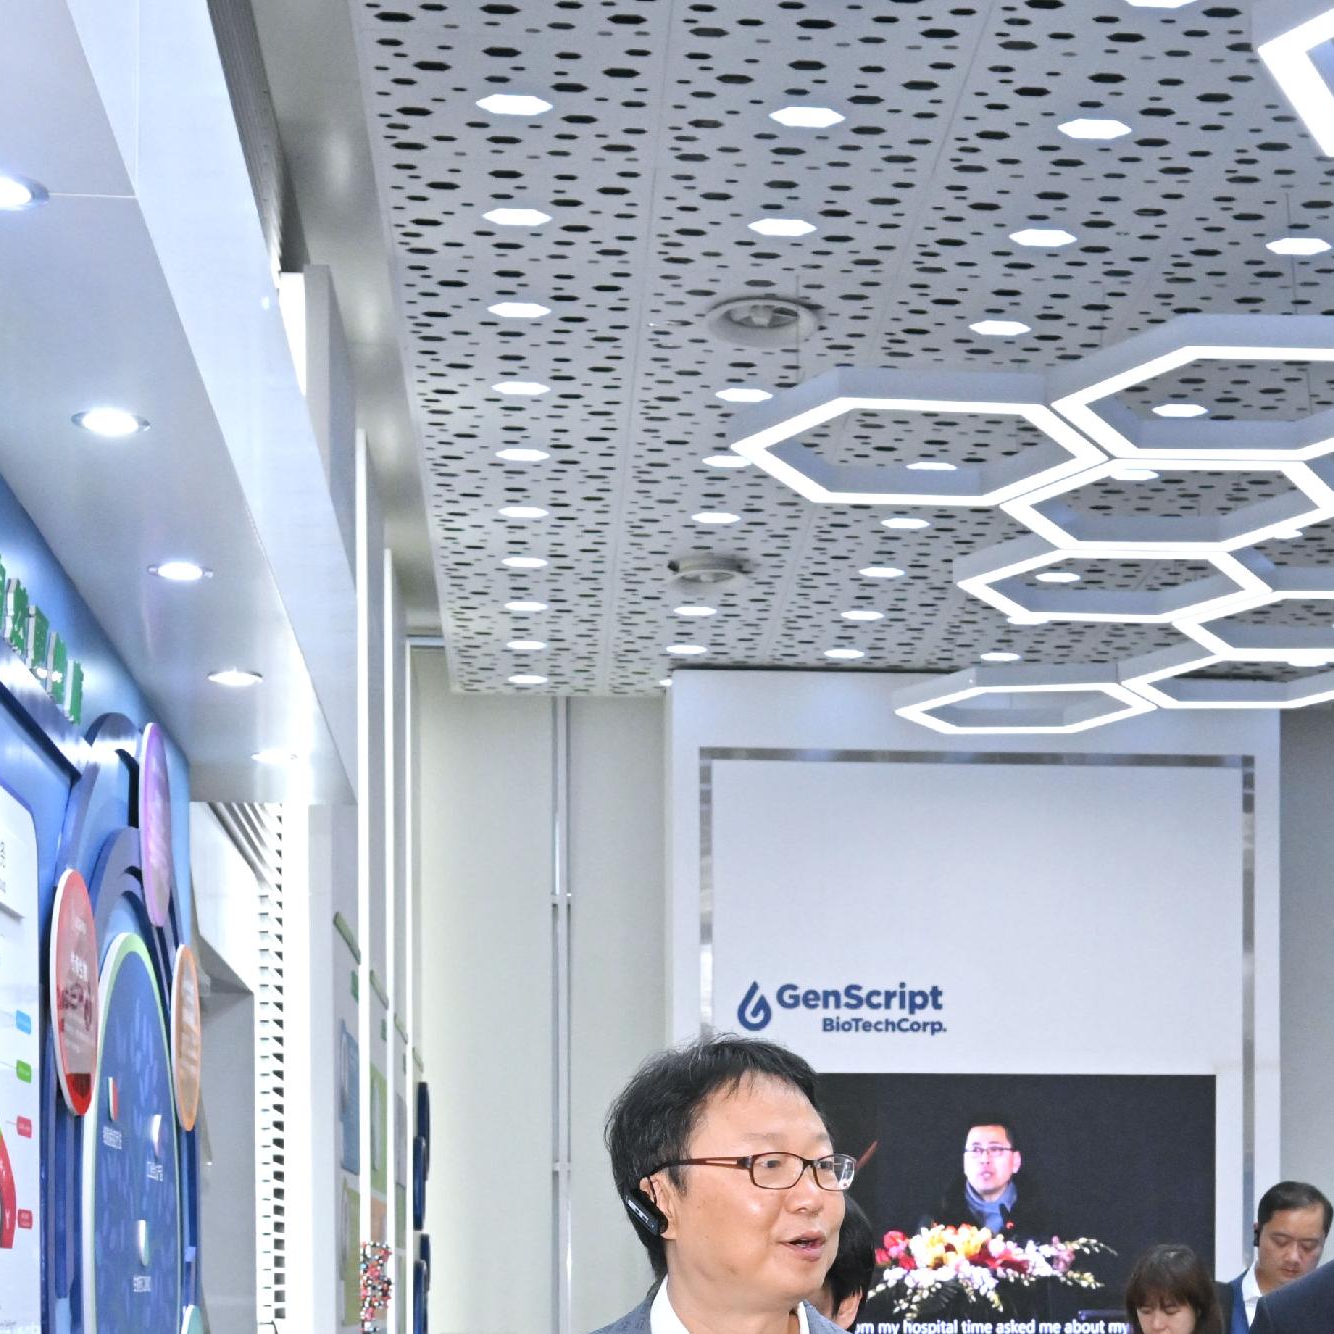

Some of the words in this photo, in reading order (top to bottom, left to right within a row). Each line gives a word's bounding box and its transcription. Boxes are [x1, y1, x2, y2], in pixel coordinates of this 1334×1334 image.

[776, 982, 943, 1015] GenScript
[822, 1018, 947, 1035] BioTechCorp.
[856, 1324, 874, 1334] om
[961, 1320, 993, 1334] time
[995, 1320, 1035, 1334] asked
[1039, 1323, 1061, 1334] me
[1064, 1320, 1105, 1334] about
